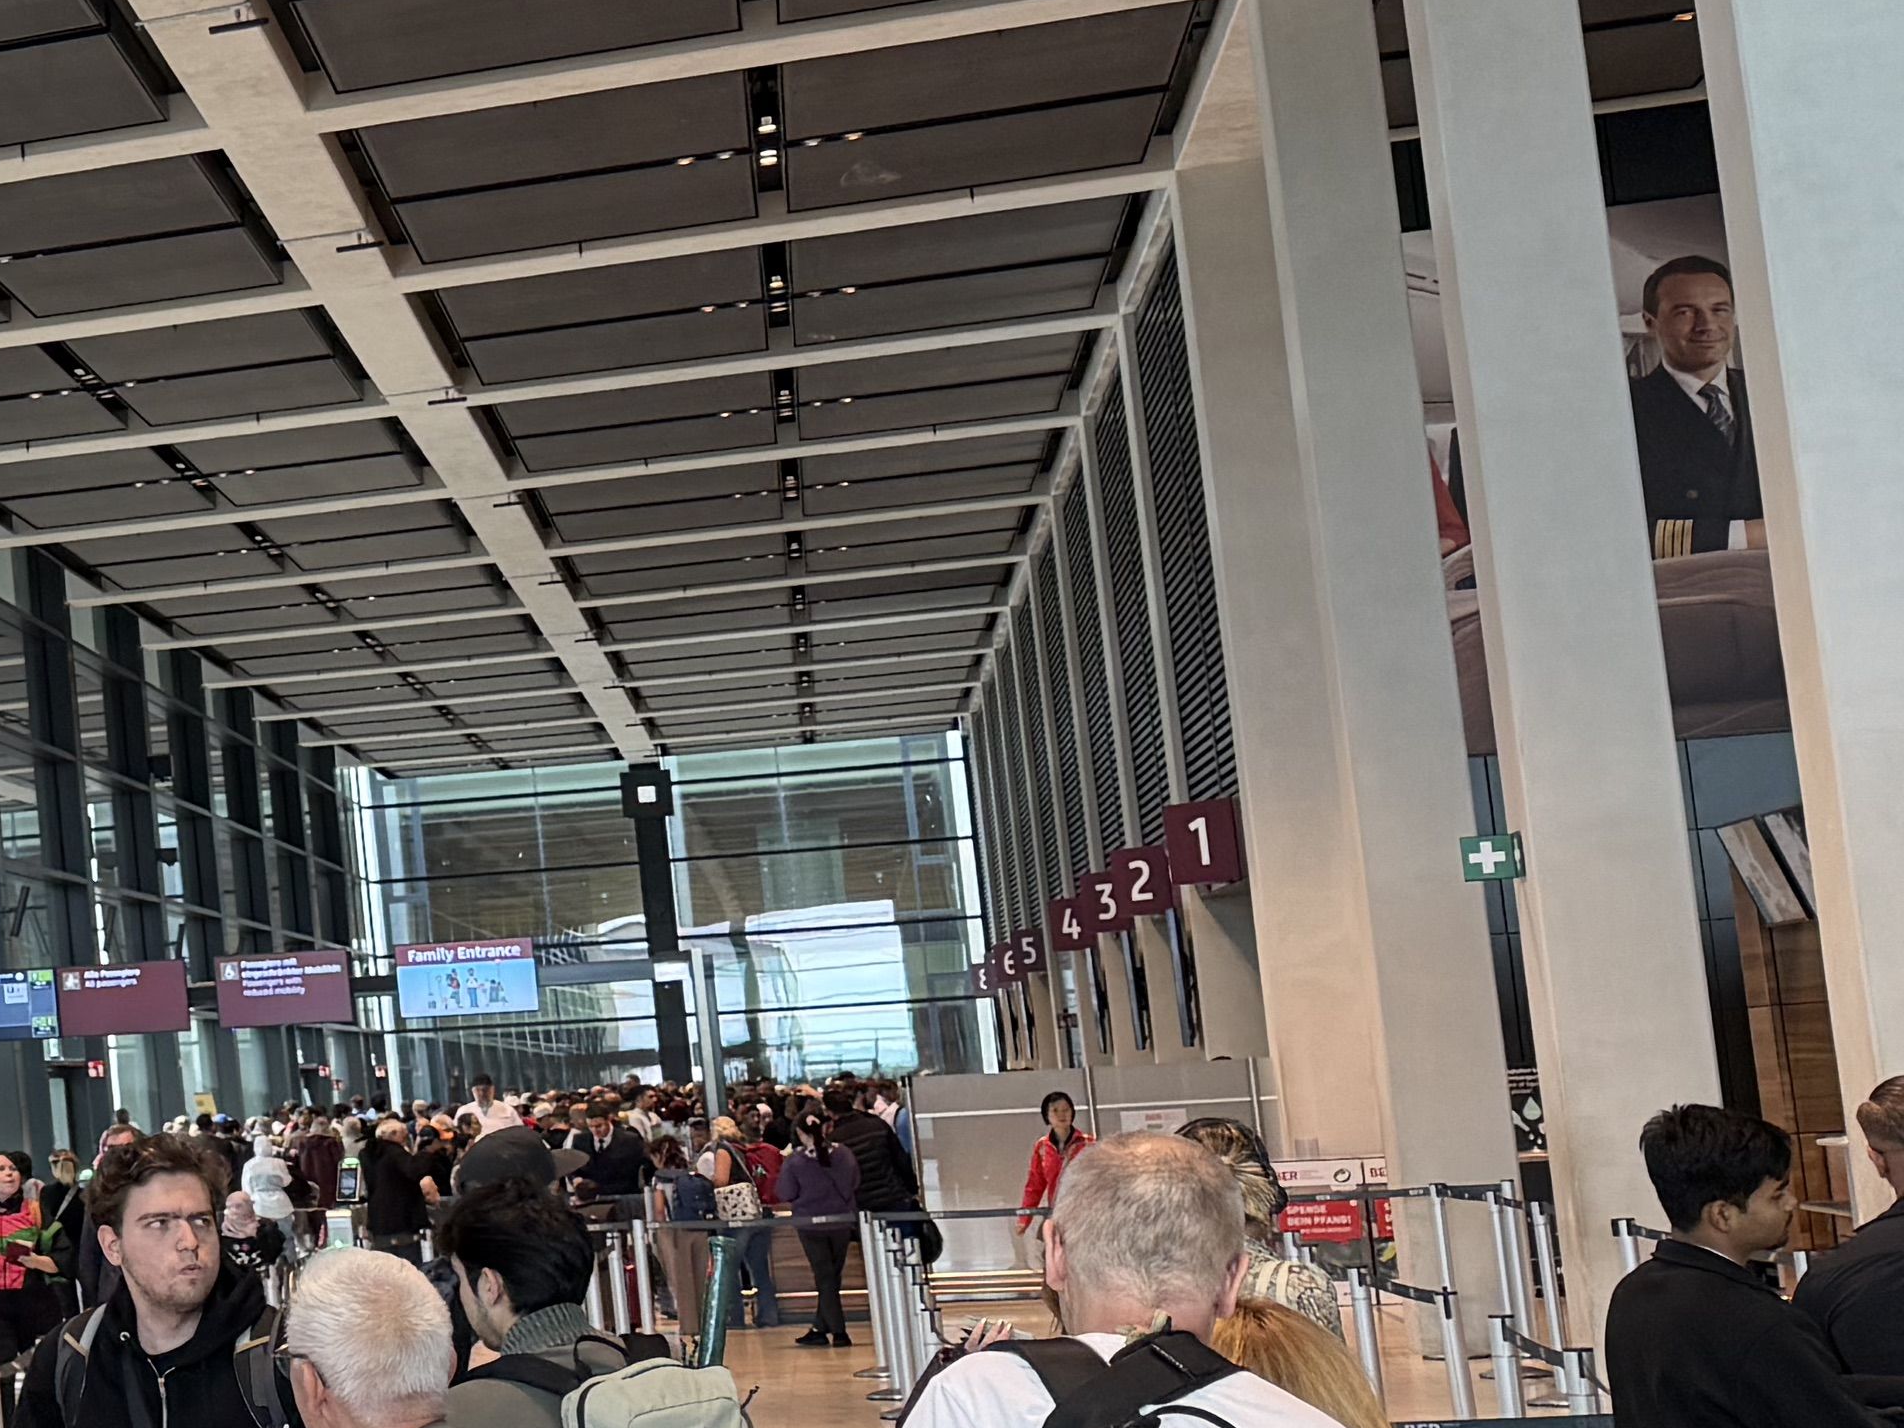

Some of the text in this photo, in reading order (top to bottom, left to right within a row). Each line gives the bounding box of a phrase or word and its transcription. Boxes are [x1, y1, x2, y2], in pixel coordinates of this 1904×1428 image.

[1187, 816, 1211, 866] 1
[1128, 859, 1154, 902] 2
[1094, 883, 1117, 920] 3
[1061, 908, 1082, 940] 4
[407, 944, 522, 964] Family Entrance
[1021, 936, 1037, 965] 5
